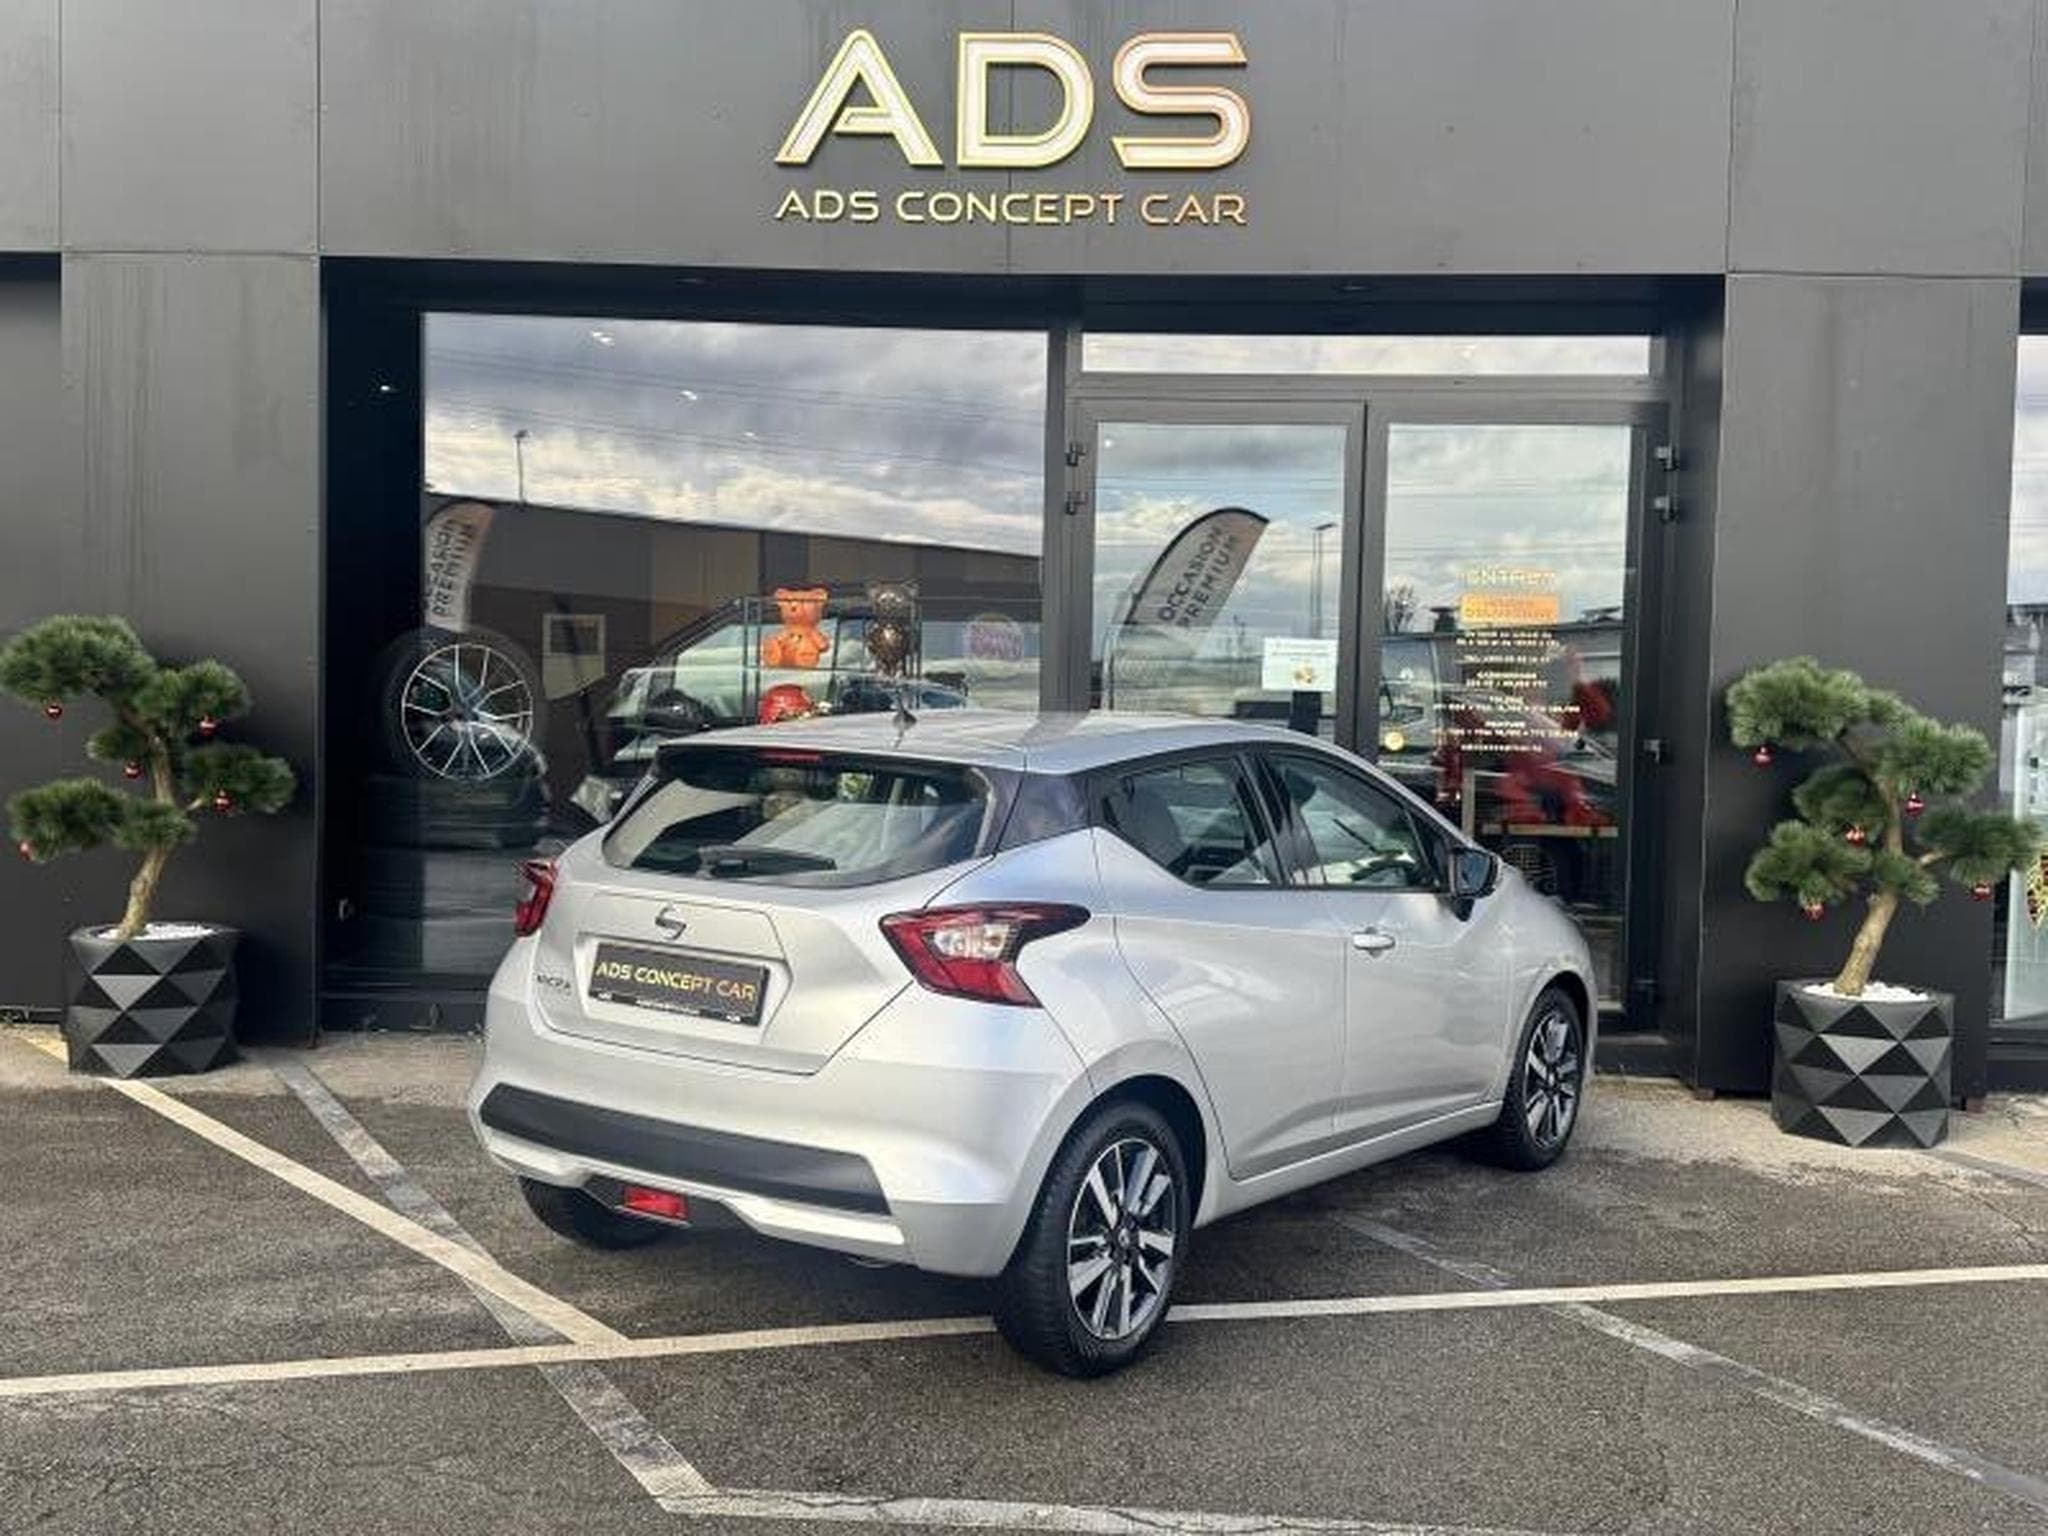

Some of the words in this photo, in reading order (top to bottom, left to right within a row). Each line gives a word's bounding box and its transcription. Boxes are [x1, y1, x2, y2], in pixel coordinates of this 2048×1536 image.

[774, 29, 1251, 169] ADS
[774, 190, 880, 221] ADS
[896, 190, 1124, 225] CONCEPT
[1140, 193, 1248, 225] CAR
[1158, 525, 1222, 621] OCCASION
[1176, 534, 1240, 630] PREMIUM
[595, 962, 633, 980] ADS
[634, 966, 714, 994] CONCEPT
[716, 979, 757, 1001] CAR
